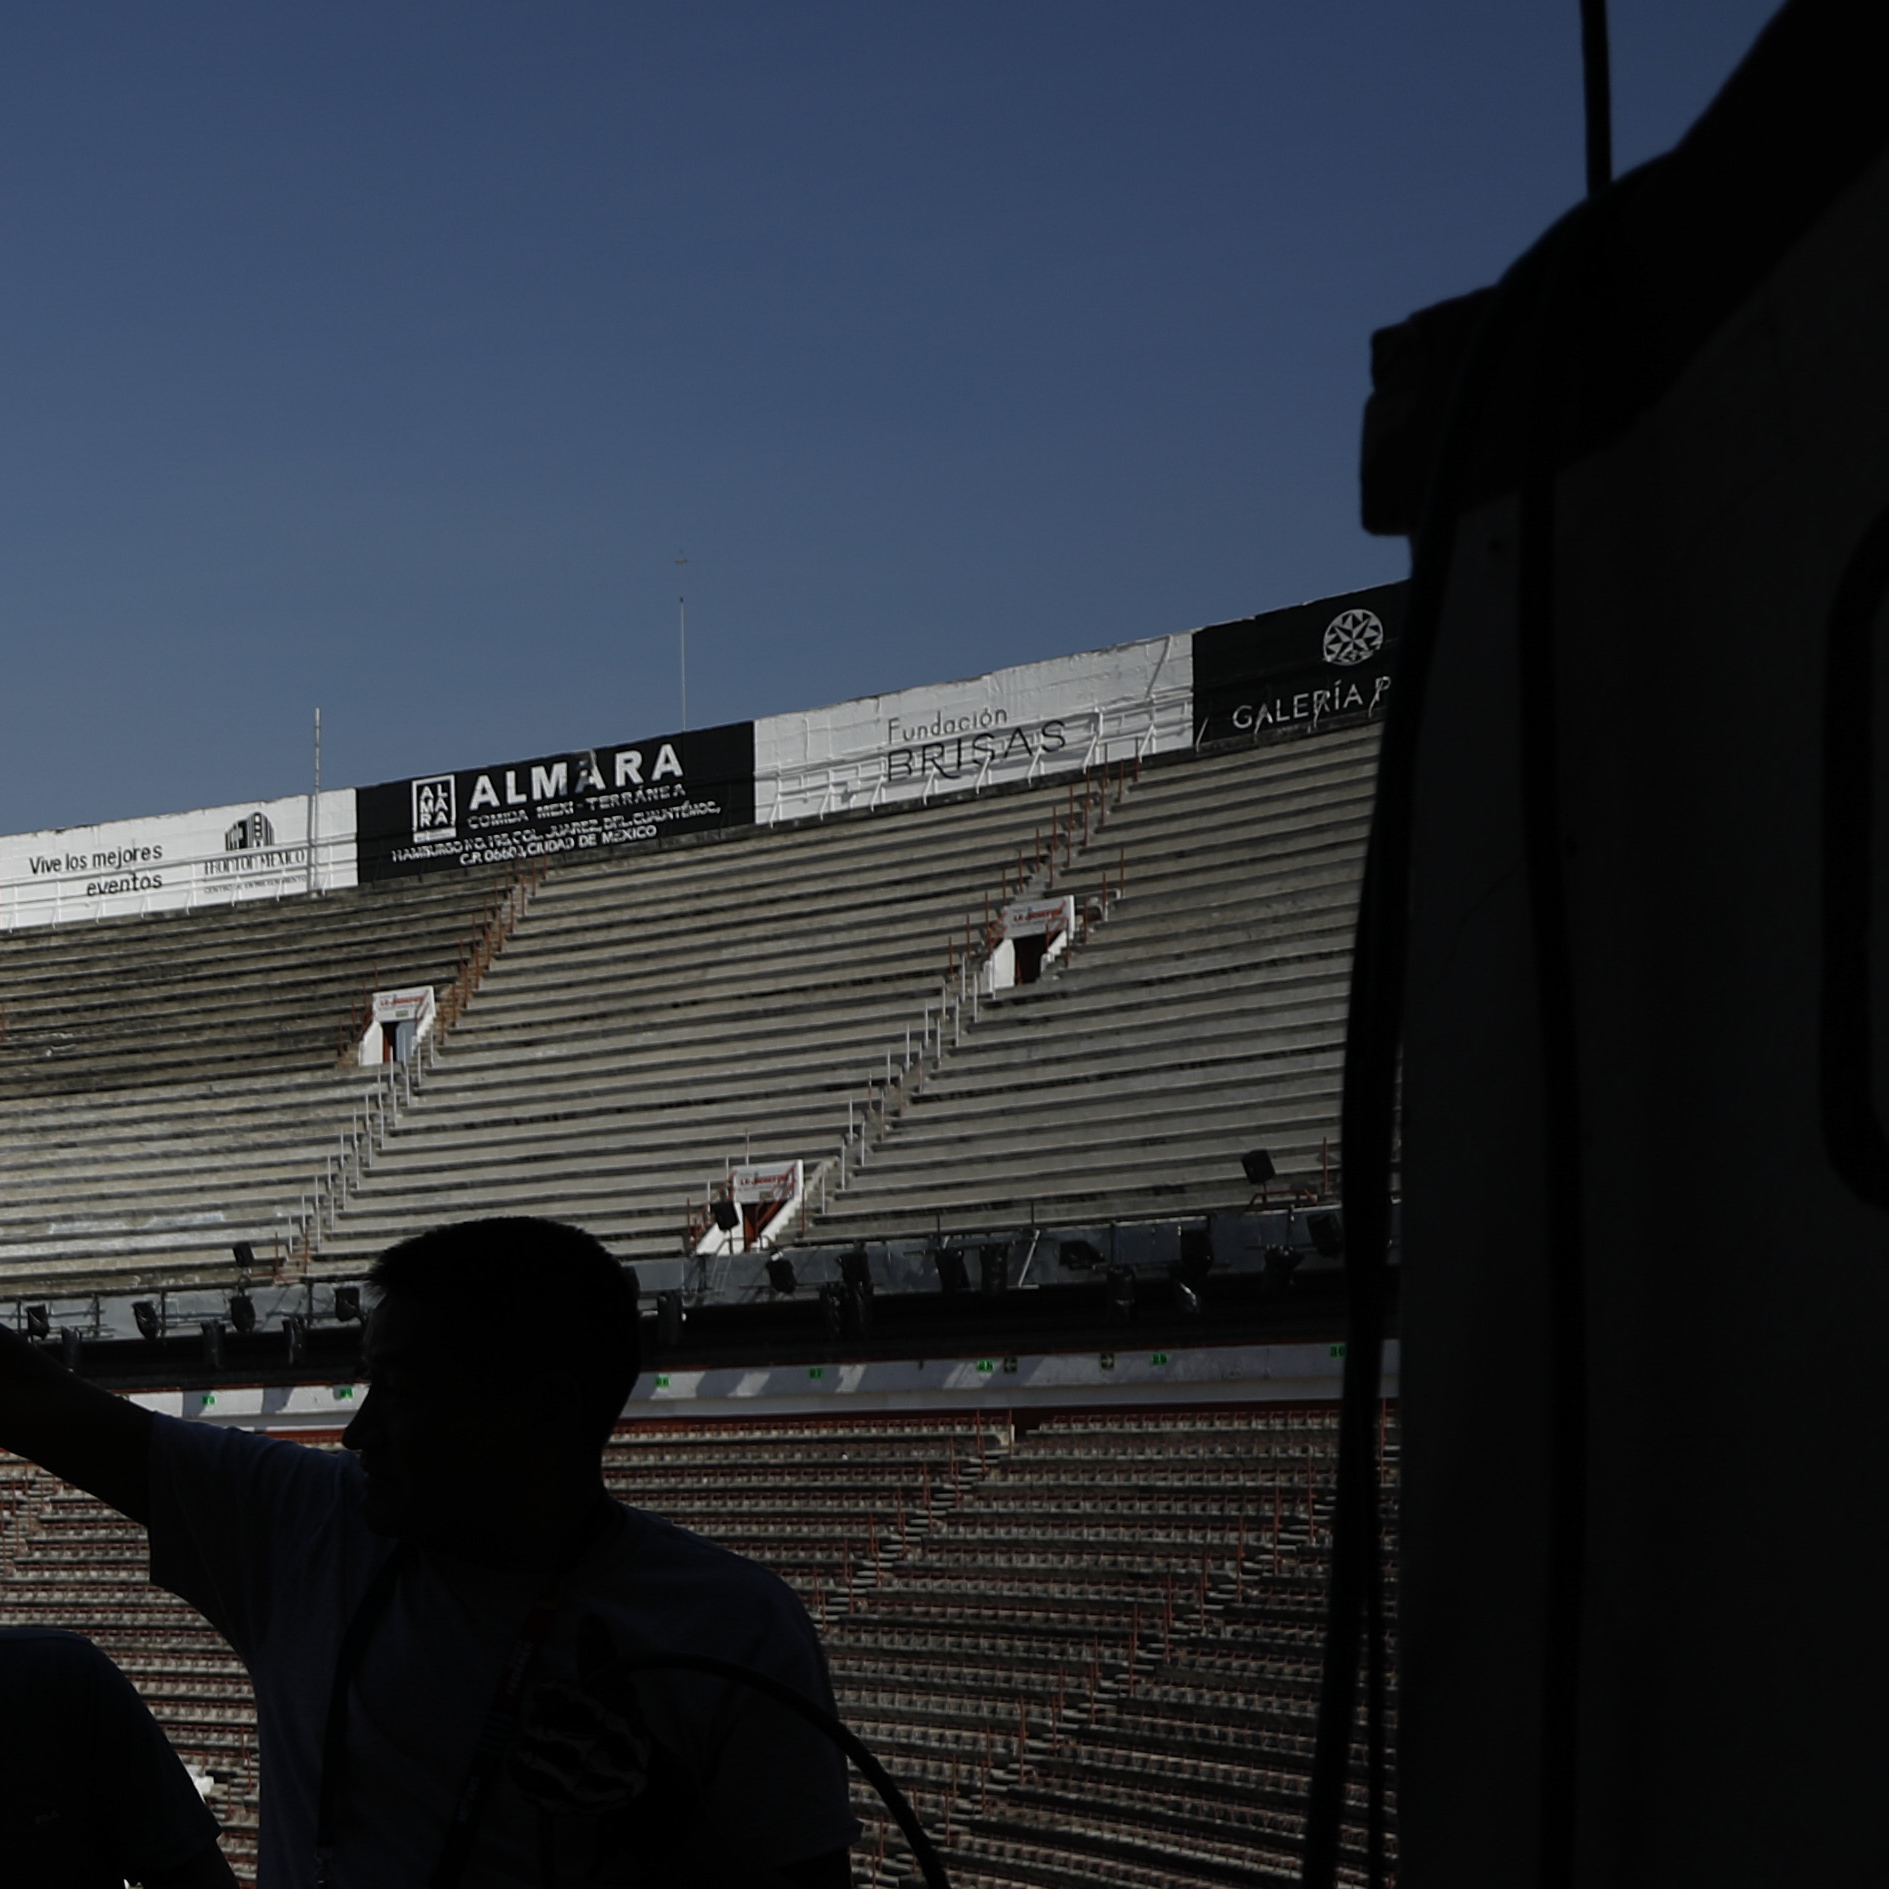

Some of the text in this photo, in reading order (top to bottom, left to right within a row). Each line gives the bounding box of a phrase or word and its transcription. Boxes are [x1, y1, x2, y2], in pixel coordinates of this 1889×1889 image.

[1232, 679, 1364, 733] GALERÍA
[888, 707, 1007, 745] Fundación
[888, 719, 1066, 782] BRISAS
[469, 743, 683, 811] ALMARA
[466, 807, 528, 831] COMIDA
[578, 833, 597, 848] DE
[29, 843, 162, 875] Vive los mejores
[86, 873, 162, 897] eventos
